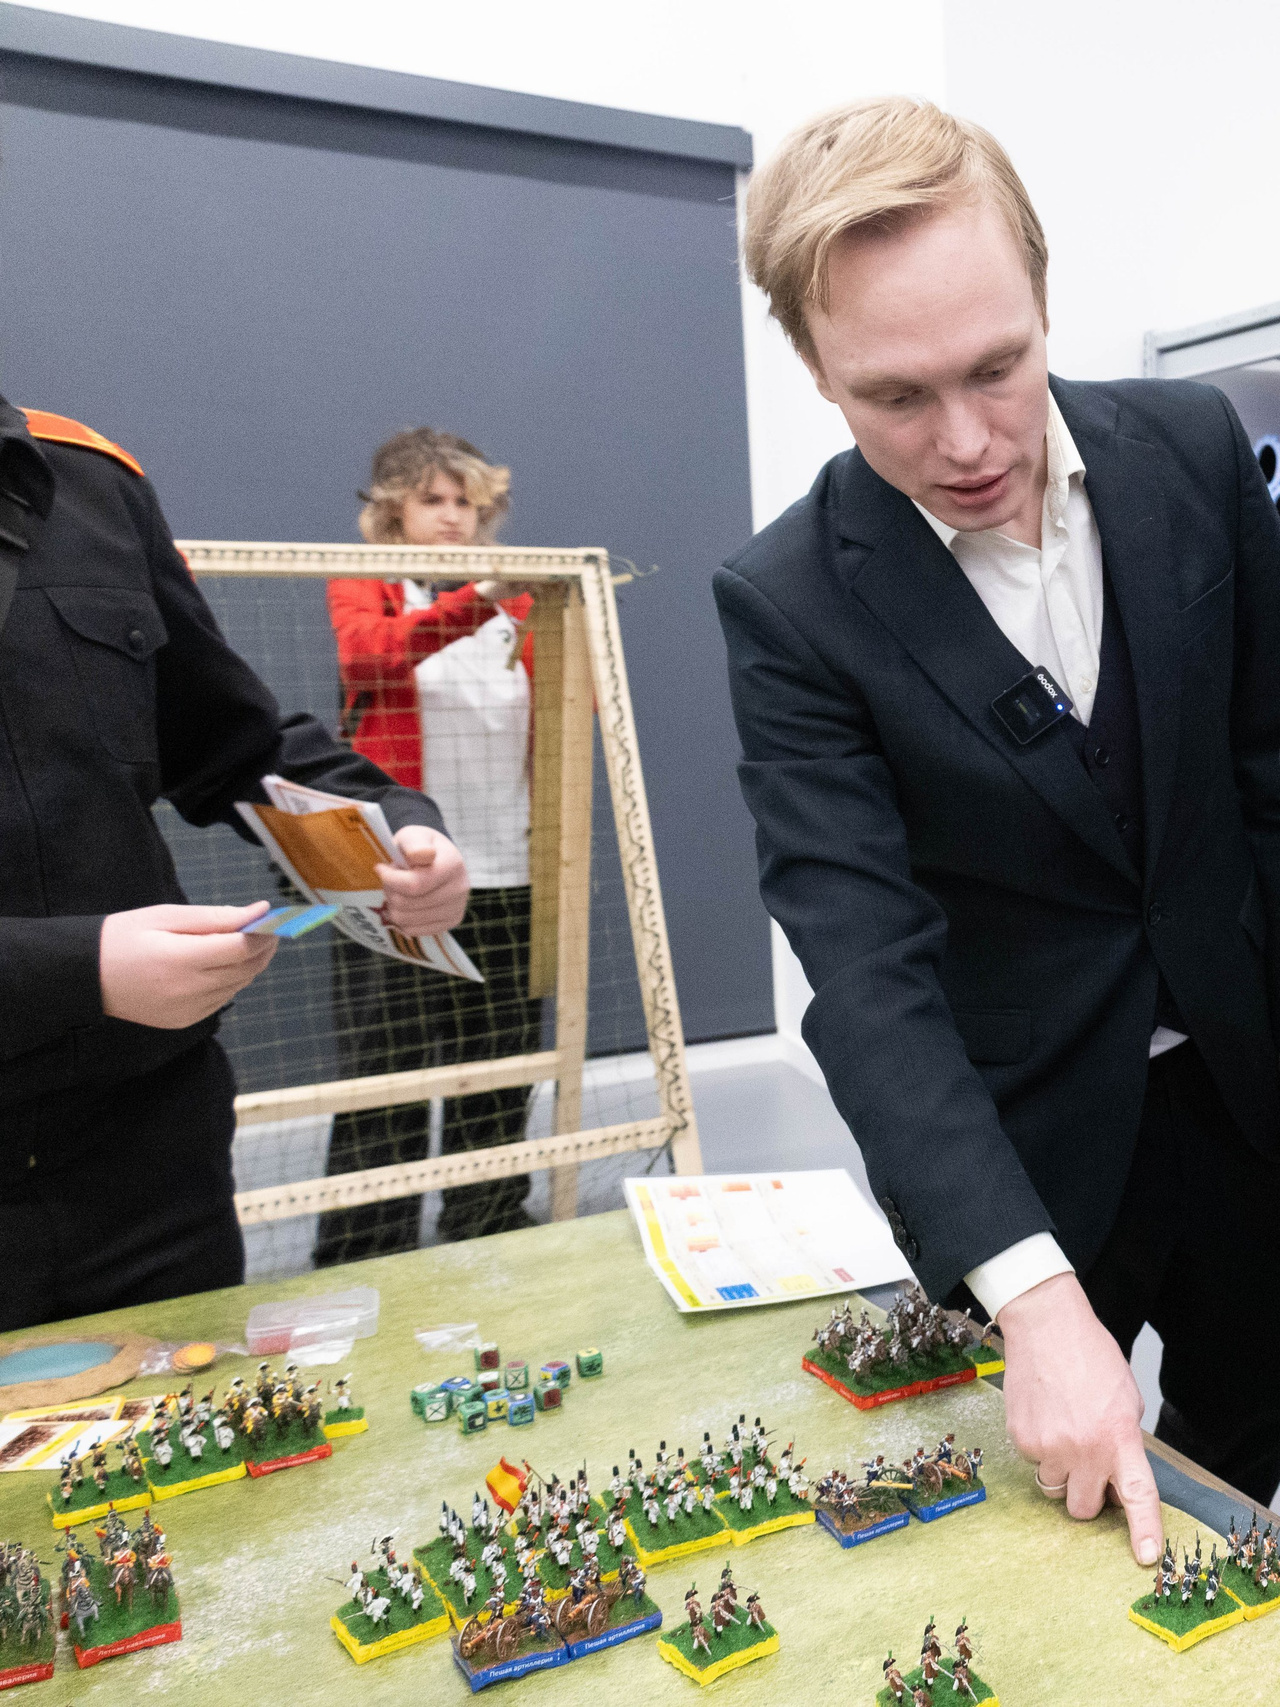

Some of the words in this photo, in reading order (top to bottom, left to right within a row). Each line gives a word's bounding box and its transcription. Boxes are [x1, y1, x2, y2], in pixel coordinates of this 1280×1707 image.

[1037, 673, 1057, 698] Godox
[584, 1638, 607, 1650] Пешая
[607, 1623, 646, 1642] артиллерия
[489, 1666, 513, 1678] Пешая
[513, 1656, 554, 1672] артиллерия
